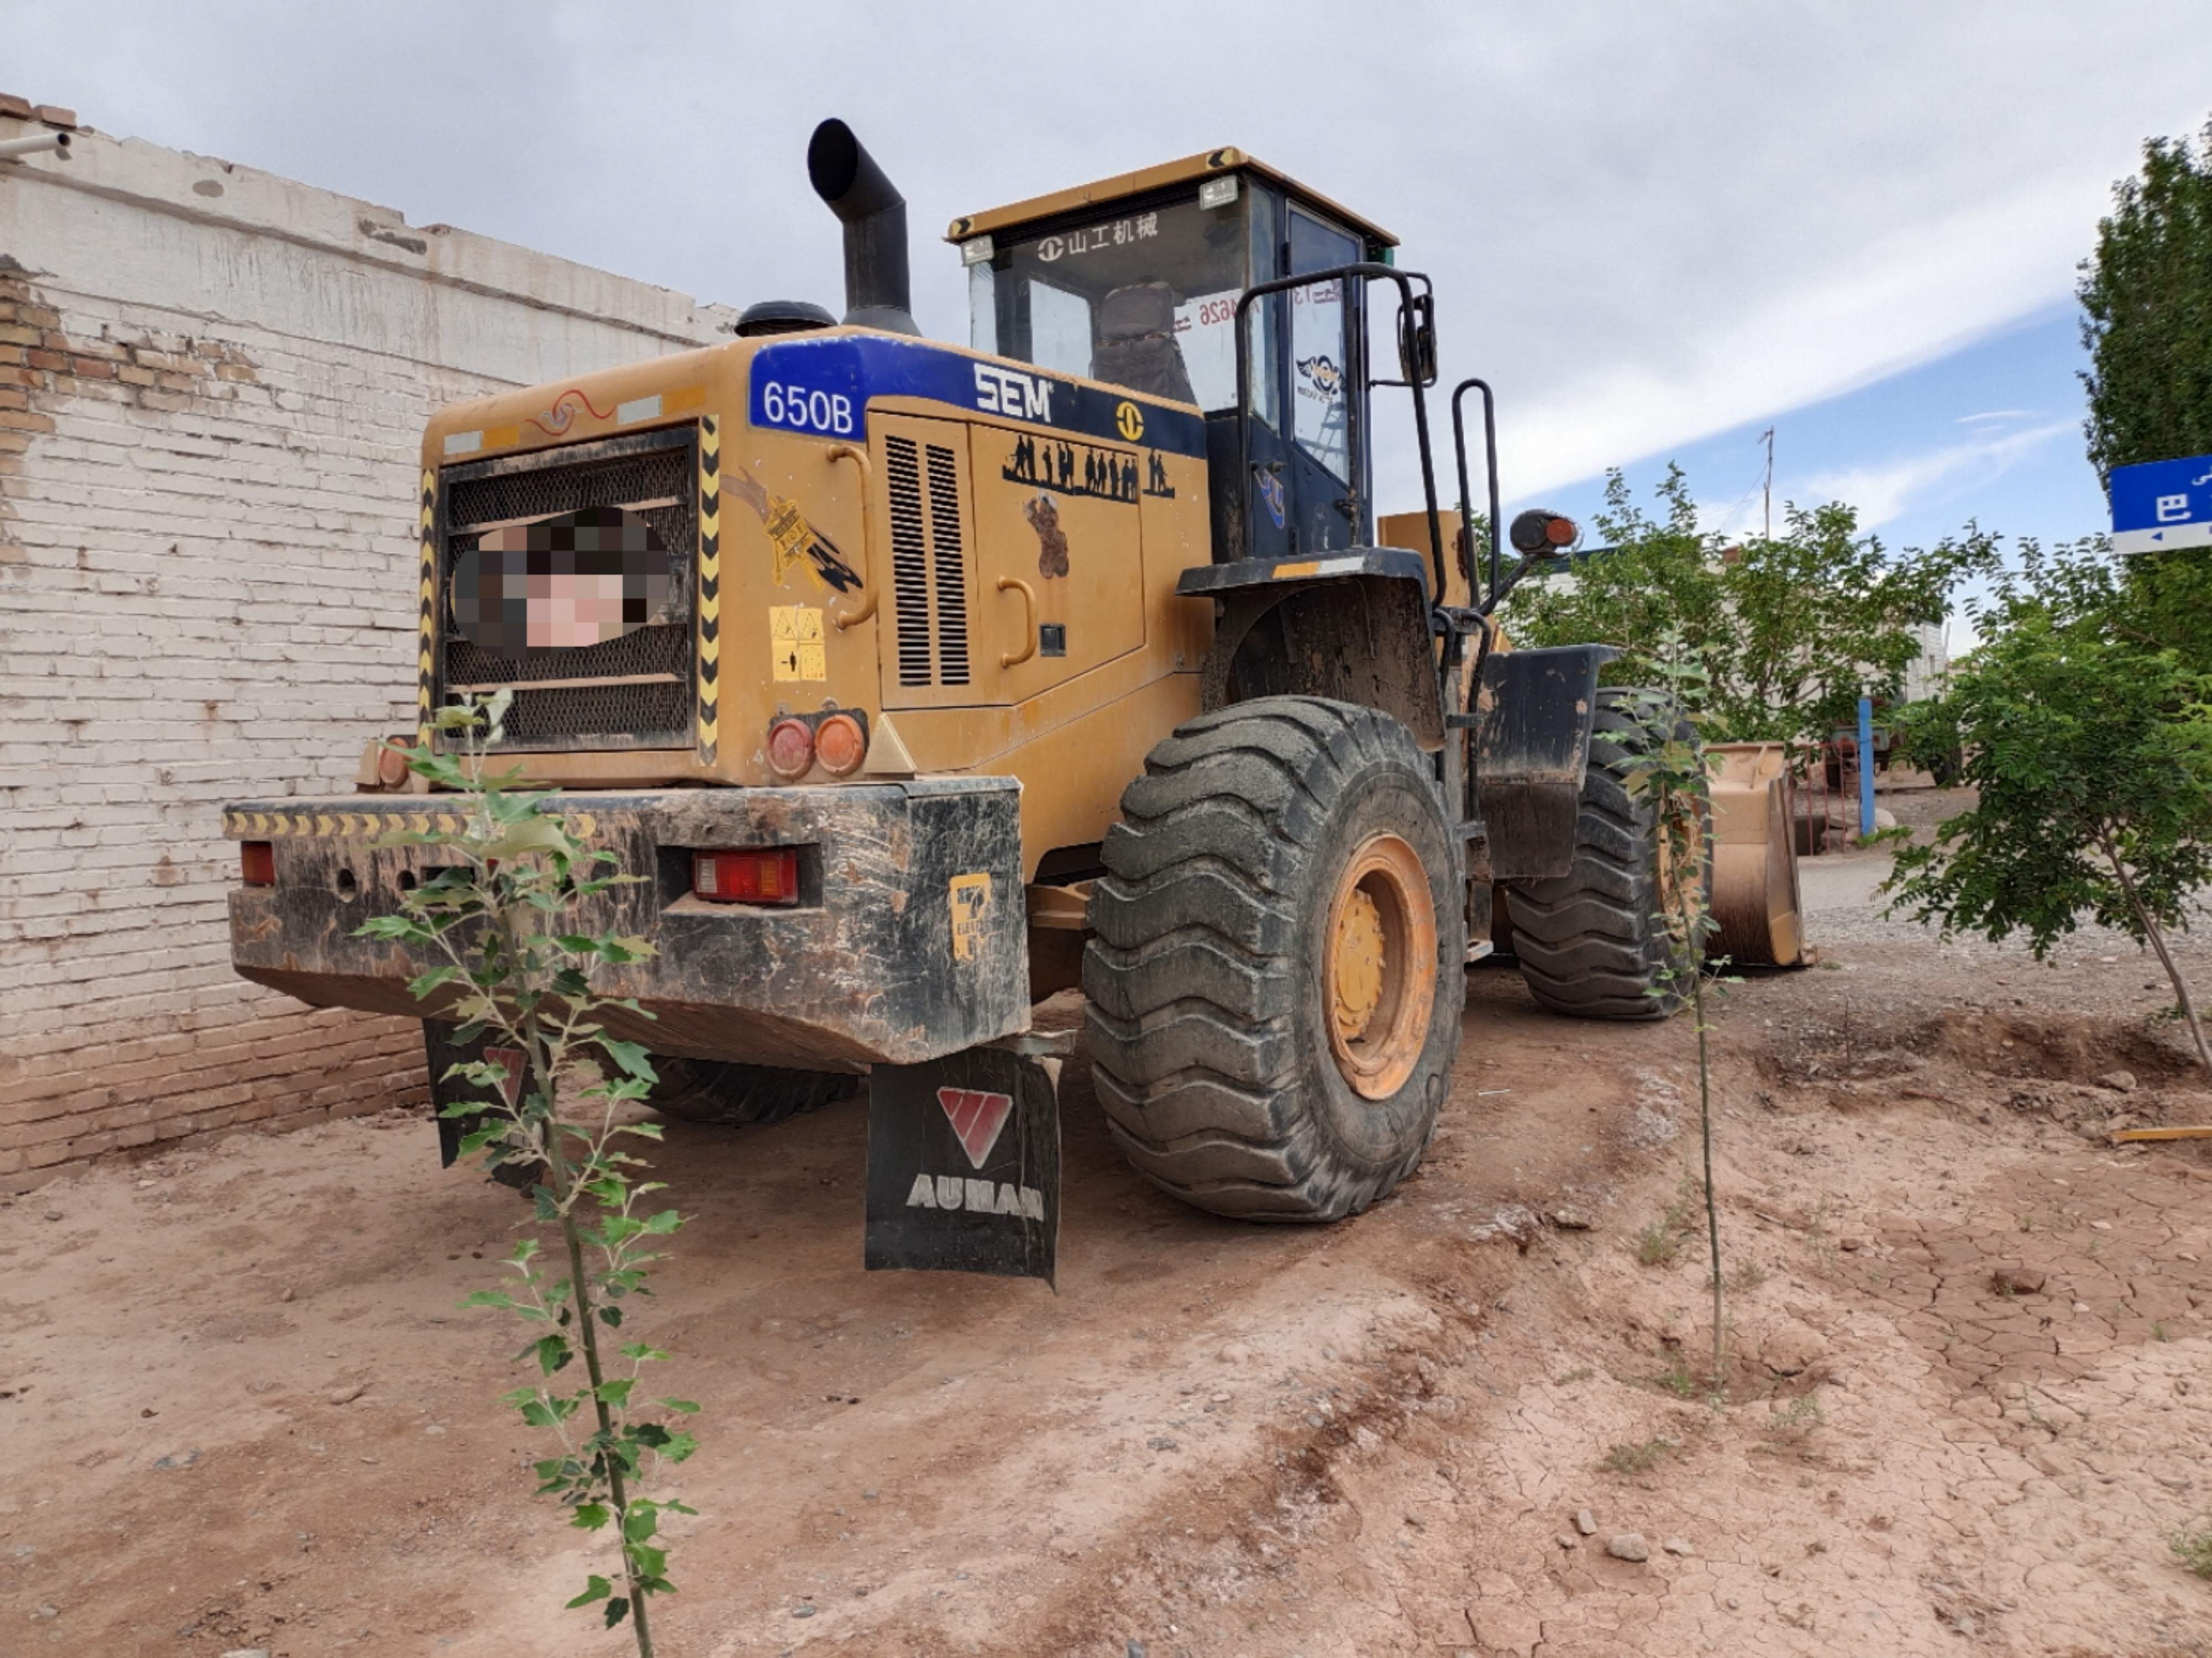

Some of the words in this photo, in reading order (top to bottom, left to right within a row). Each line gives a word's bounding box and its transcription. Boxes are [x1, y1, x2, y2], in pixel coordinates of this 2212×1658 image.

[1068, 212, 1158, 255] 山工机械
[764, 381, 853, 434] 650B
[974, 363, 1051, 422] SEM
[2156, 494, 2192, 522] 巴
[905, 1173, 1044, 1222] AUMAN
